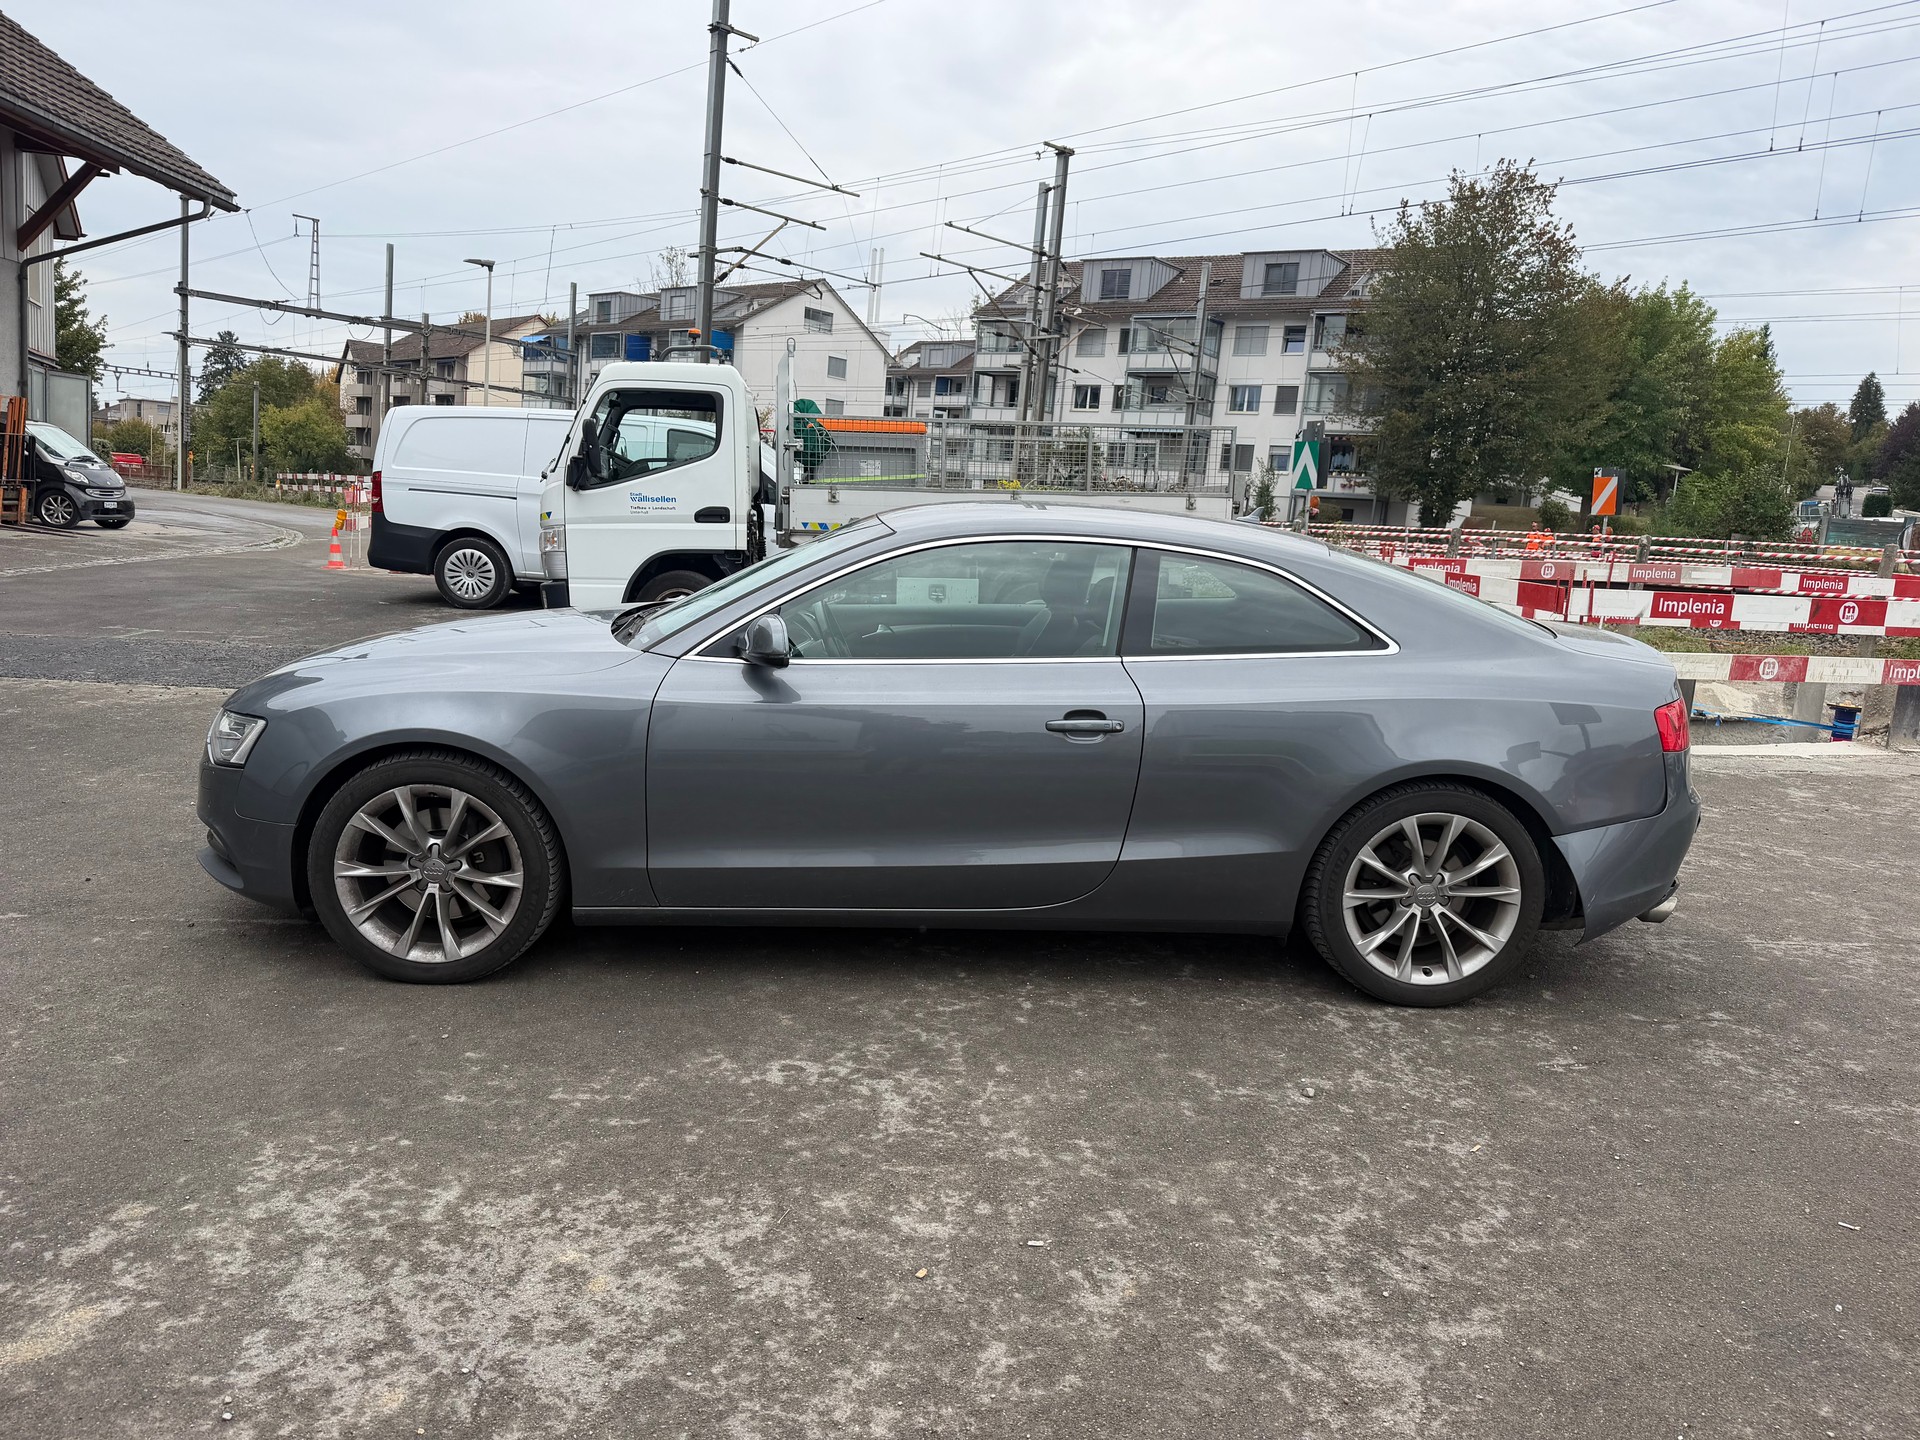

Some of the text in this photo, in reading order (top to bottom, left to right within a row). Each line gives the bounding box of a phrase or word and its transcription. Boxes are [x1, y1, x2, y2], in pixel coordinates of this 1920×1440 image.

[1633, 567, 1676, 580] Implenia
[1803, 578, 1844, 591] Implenia
[1658, 597, 1725, 616] Implenia
